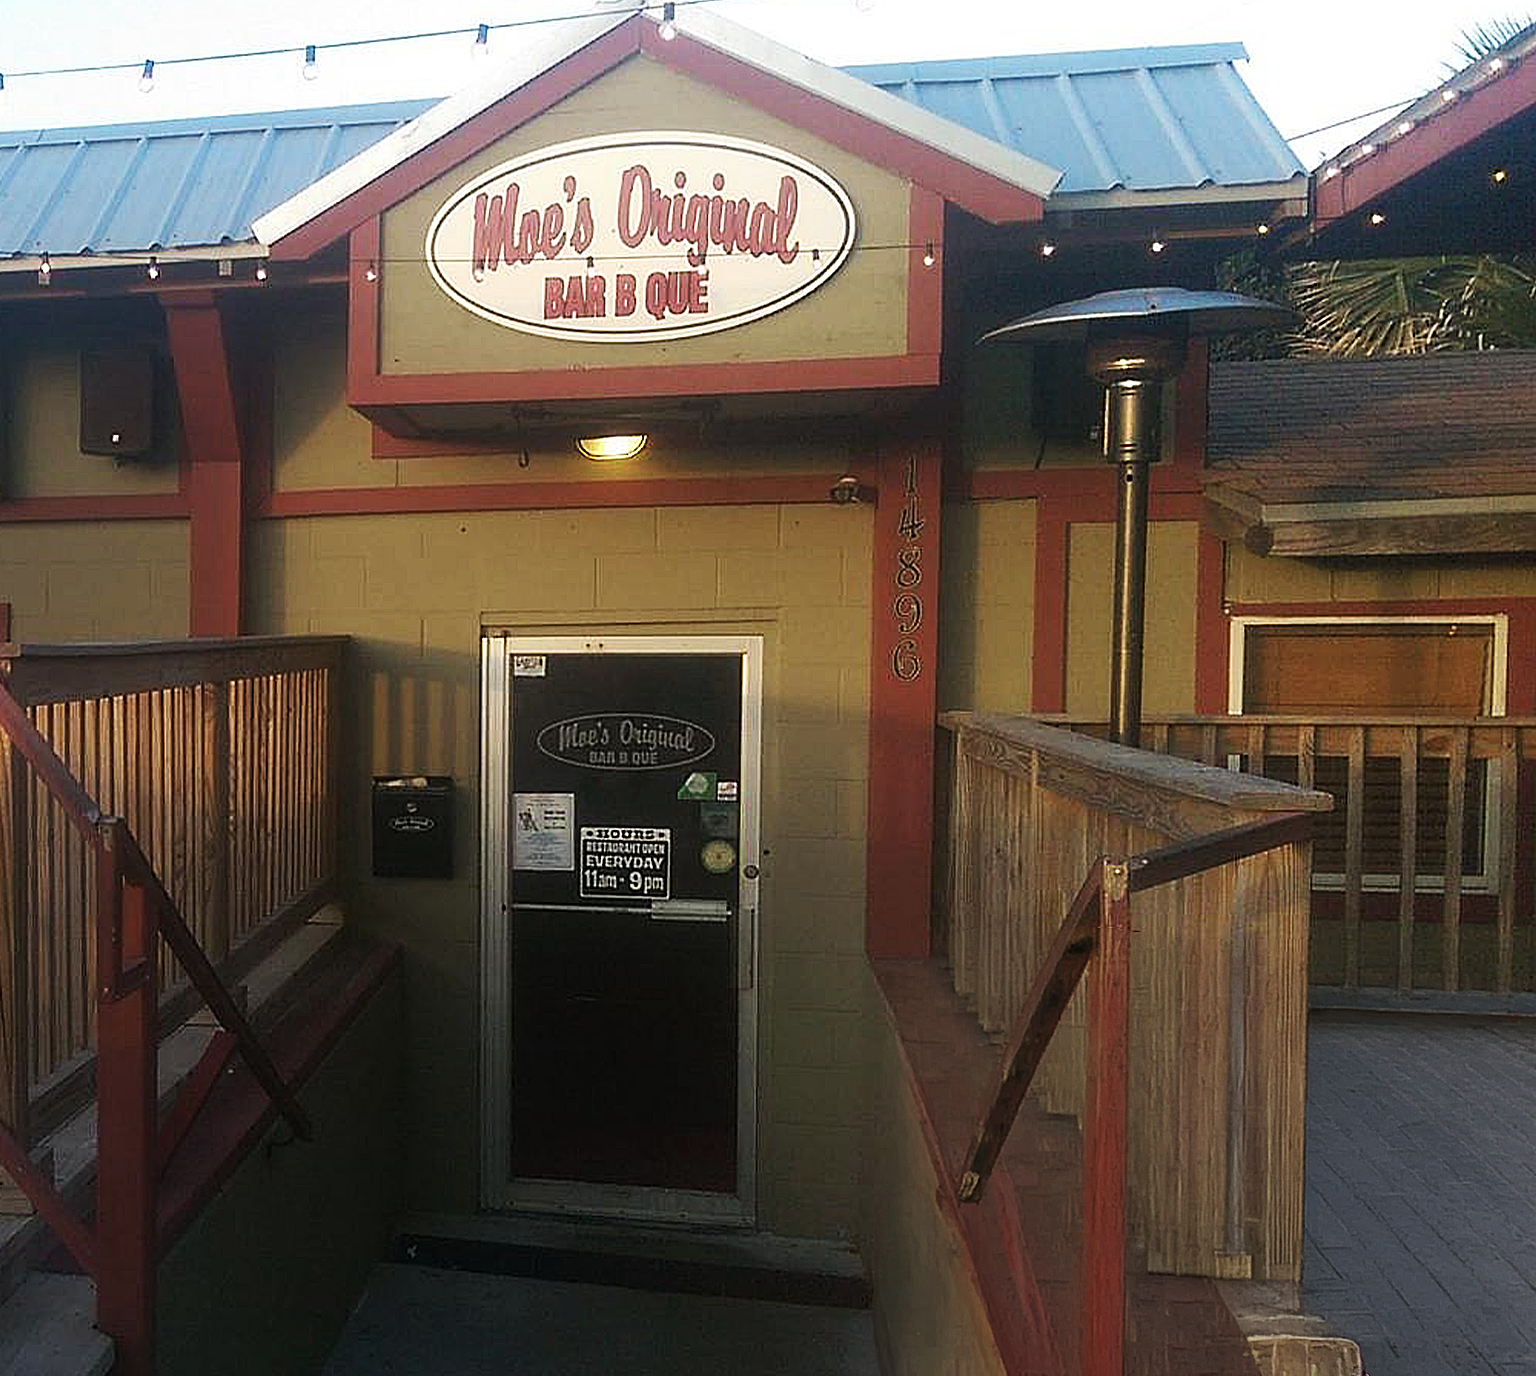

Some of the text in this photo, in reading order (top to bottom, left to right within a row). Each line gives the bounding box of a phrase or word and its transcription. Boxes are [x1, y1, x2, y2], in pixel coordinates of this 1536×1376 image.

[472, 165, 799, 281] Moe's Original
[544, 271, 709, 319] BAR B QUE
[891, 456, 924, 681] 14896
[559, 719, 694, 751] Moe's Original
[632, 752, 658, 765] QUE
[596, 829, 655, 839] HOURS
[586, 842, 665, 855] RESTAURANT OPEN
[586, 855, 664, 869] EVERYDAY
